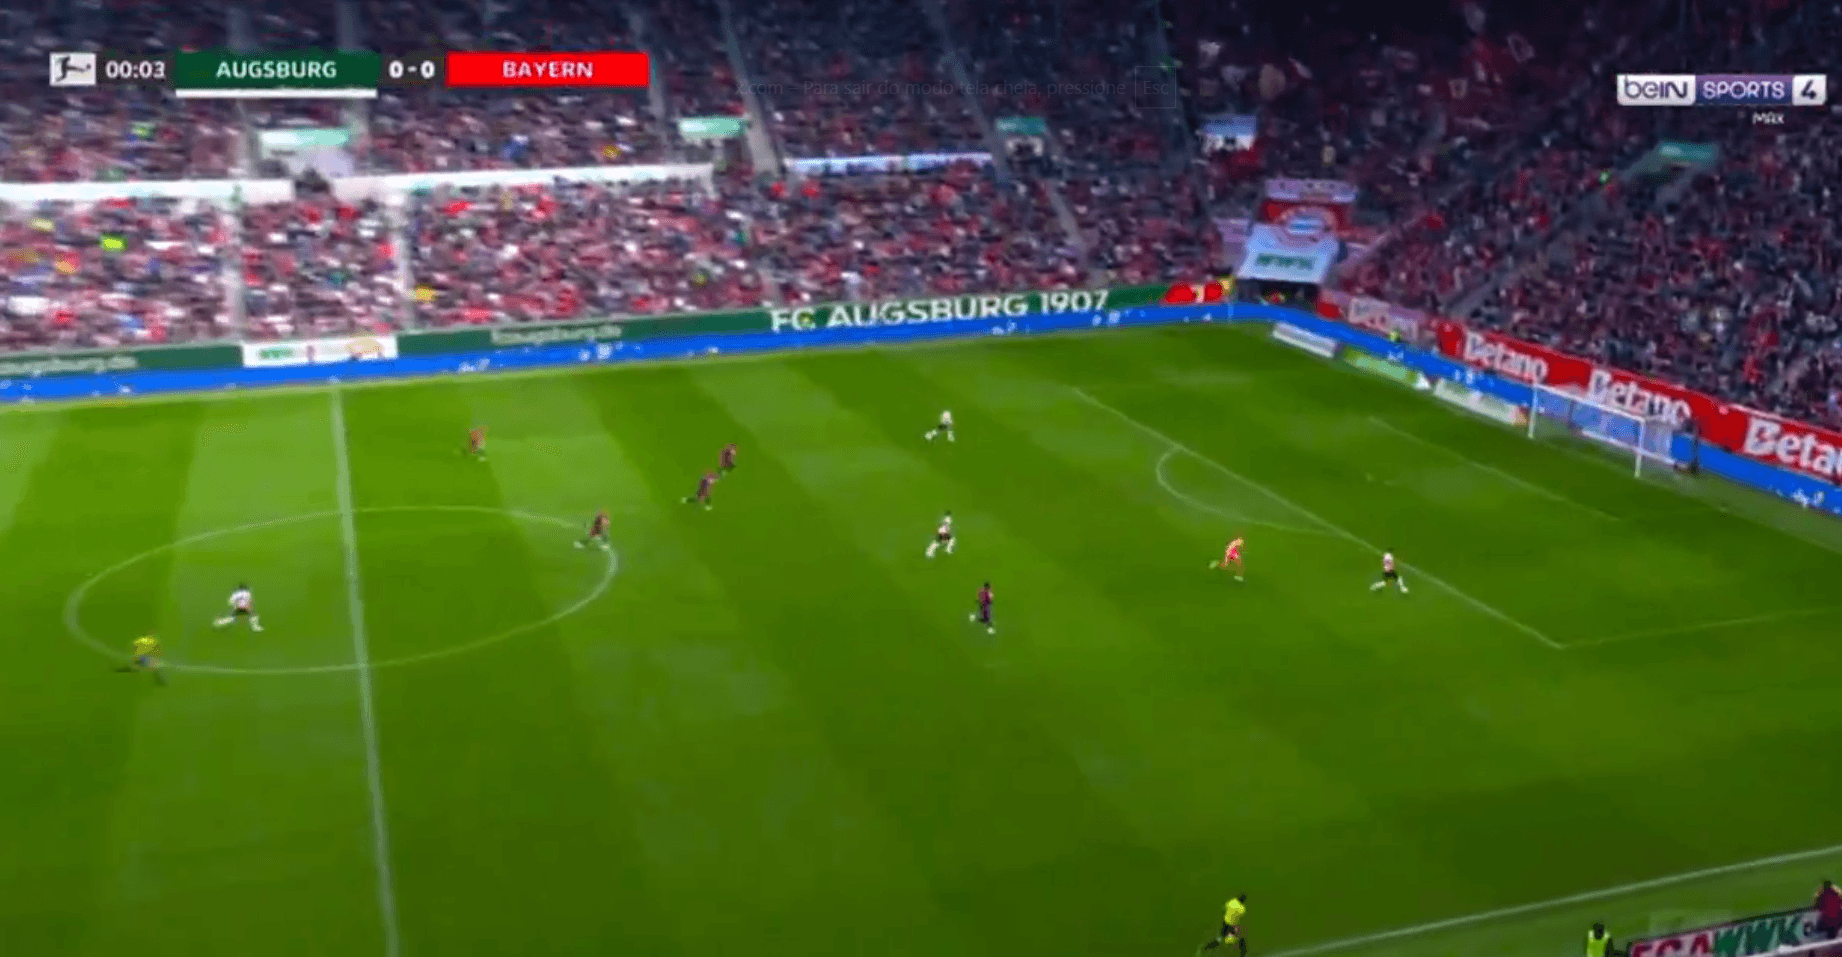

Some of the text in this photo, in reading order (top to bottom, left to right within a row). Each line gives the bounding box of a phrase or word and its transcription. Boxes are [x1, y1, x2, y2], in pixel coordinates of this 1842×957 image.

[770, 289, 1109, 332] FC AUGSBURG 1907
[1462, 331, 1548, 385] Betano
[1587, 369, 1691, 426] Betano
[1744, 416, 1842, 477] Beta
